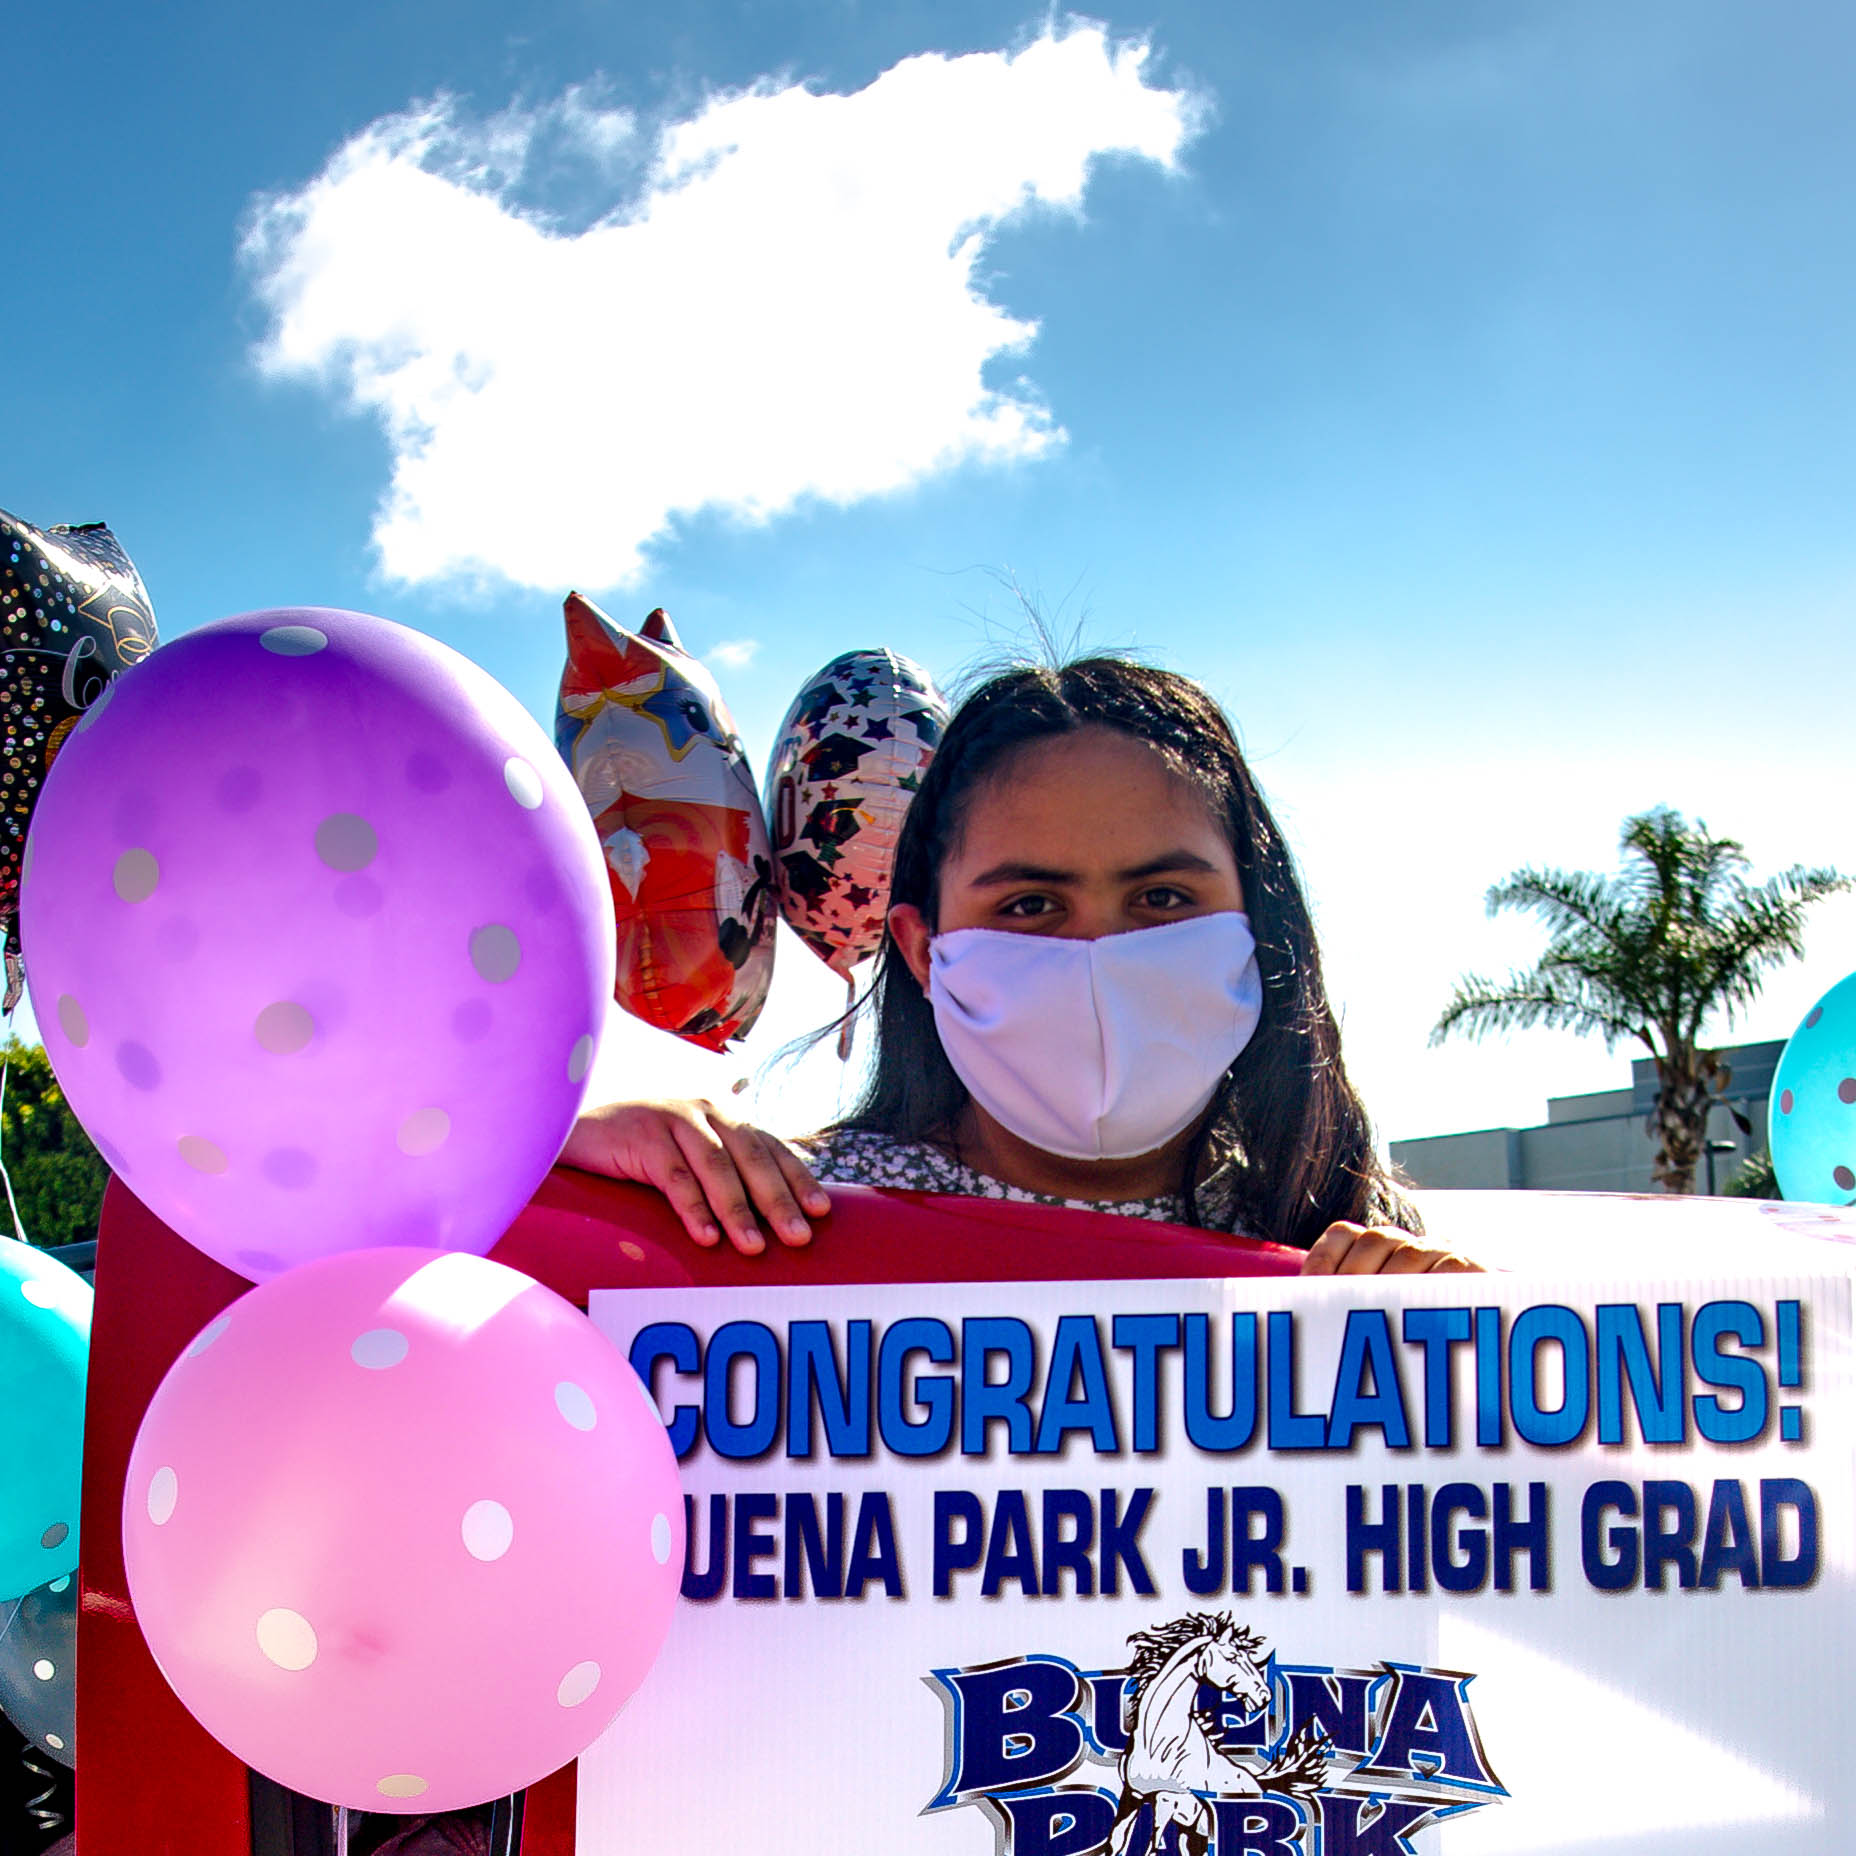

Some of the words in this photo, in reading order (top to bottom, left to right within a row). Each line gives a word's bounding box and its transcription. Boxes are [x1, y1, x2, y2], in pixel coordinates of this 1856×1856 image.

[628, 1298, 1804, 1460] CONGRATULATIONS!
[680, 1489, 902, 1600] UENA
[934, 1486, 1142, 1598] PARK
[1182, 1482, 1307, 1596] JR.
[1347, 1479, 1548, 1593] HIGH
[1580, 1475, 1819, 1590] GRAD
